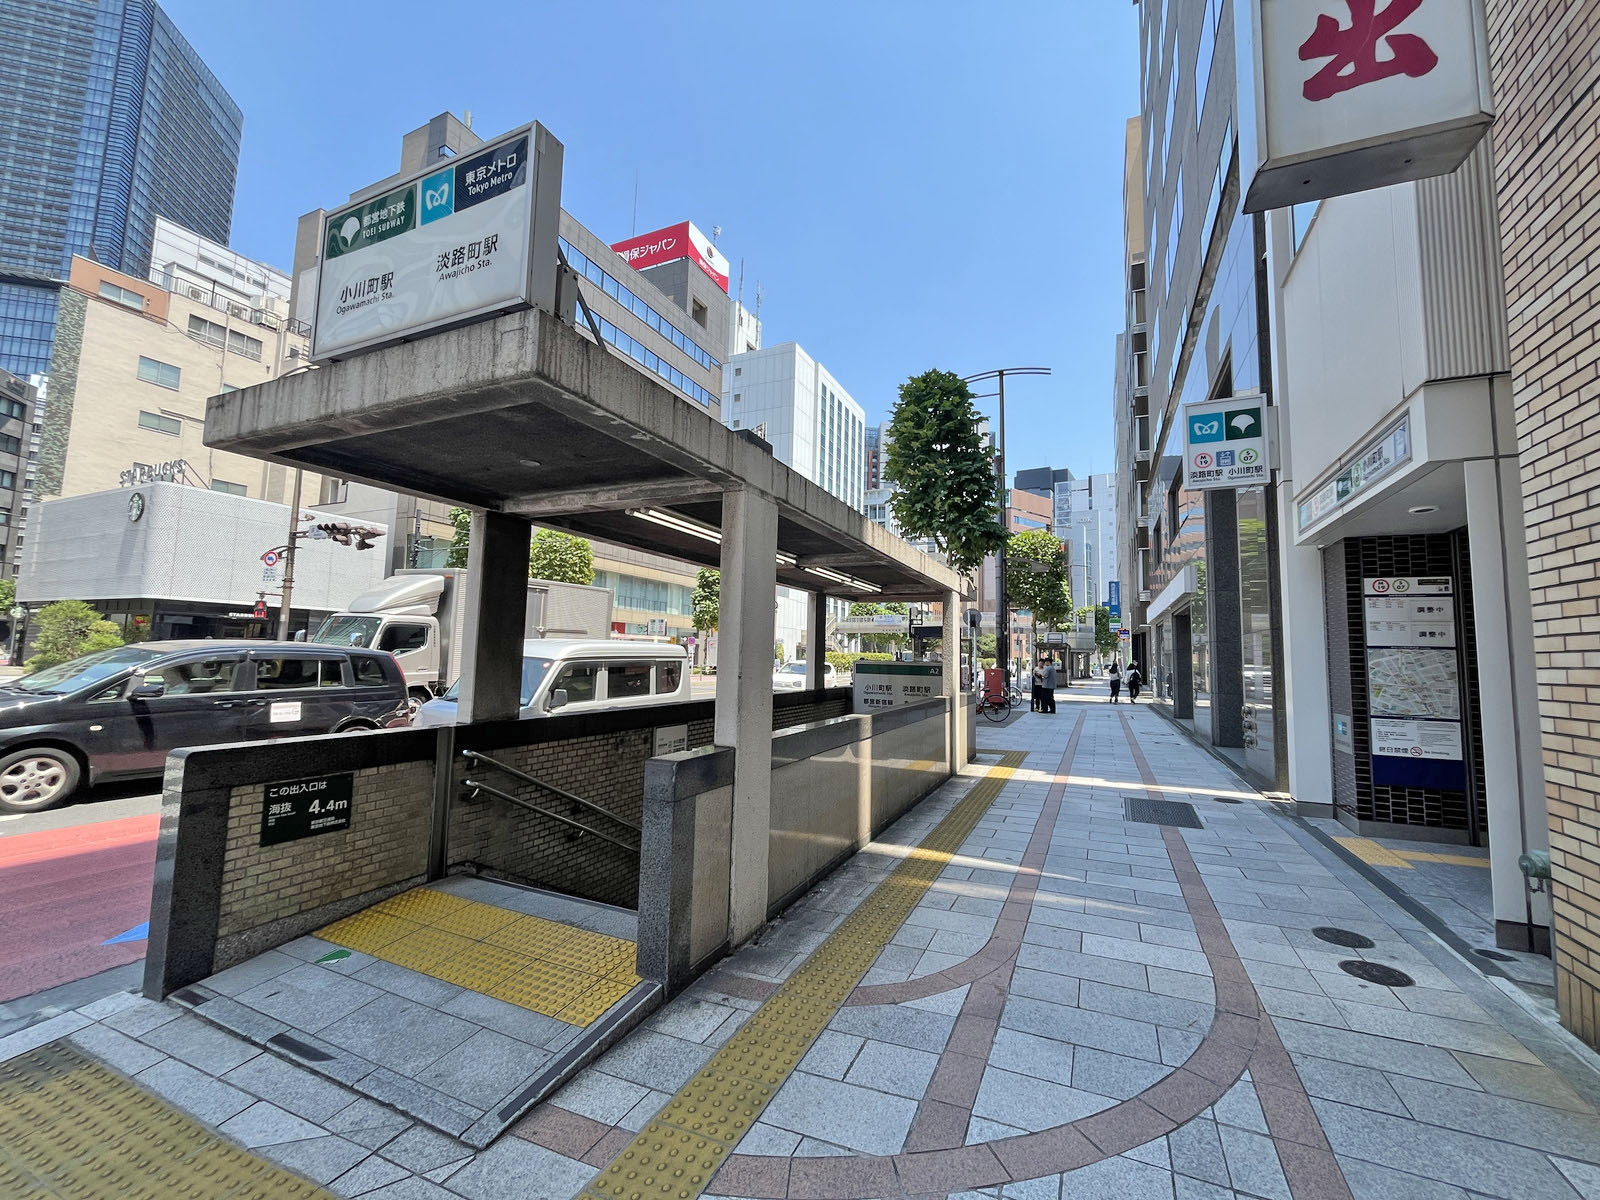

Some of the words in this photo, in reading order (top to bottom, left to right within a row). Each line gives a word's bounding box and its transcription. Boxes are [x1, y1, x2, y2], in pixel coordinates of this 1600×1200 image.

[465, 152, 517, 187] 東京メトロ
[467, 180, 490, 196] Tokyo
[490, 171, 513, 188] Metro
[362, 201, 406, 228] 都営地下鉄
[362, 224, 377, 239] TOEI
[378, 216, 405, 234] SUBWAY
[435, 233, 498, 273] 淡路町駅
[438, 264, 475, 282] Awajicho
[477, 259, 493, 272] Sta.
[340, 271, 394, 304] 小川町駅
[336, 295, 380, 315] Ogawamachi
[381, 290, 394, 302] Sta.
[119, 459, 186, 484] STARBUCKS
[1190, 469, 1224, 479] 淡路町駅
[1228, 465, 1264, 476] 小川町駅
[864, 684, 892, 692] 小川町駅
[902, 685, 931, 694] 淡路町駅
[270, 781, 327, 797] この出入口は
[268, 802, 292, 815] 海抜
[308, 799, 348, 814] 4.4m
